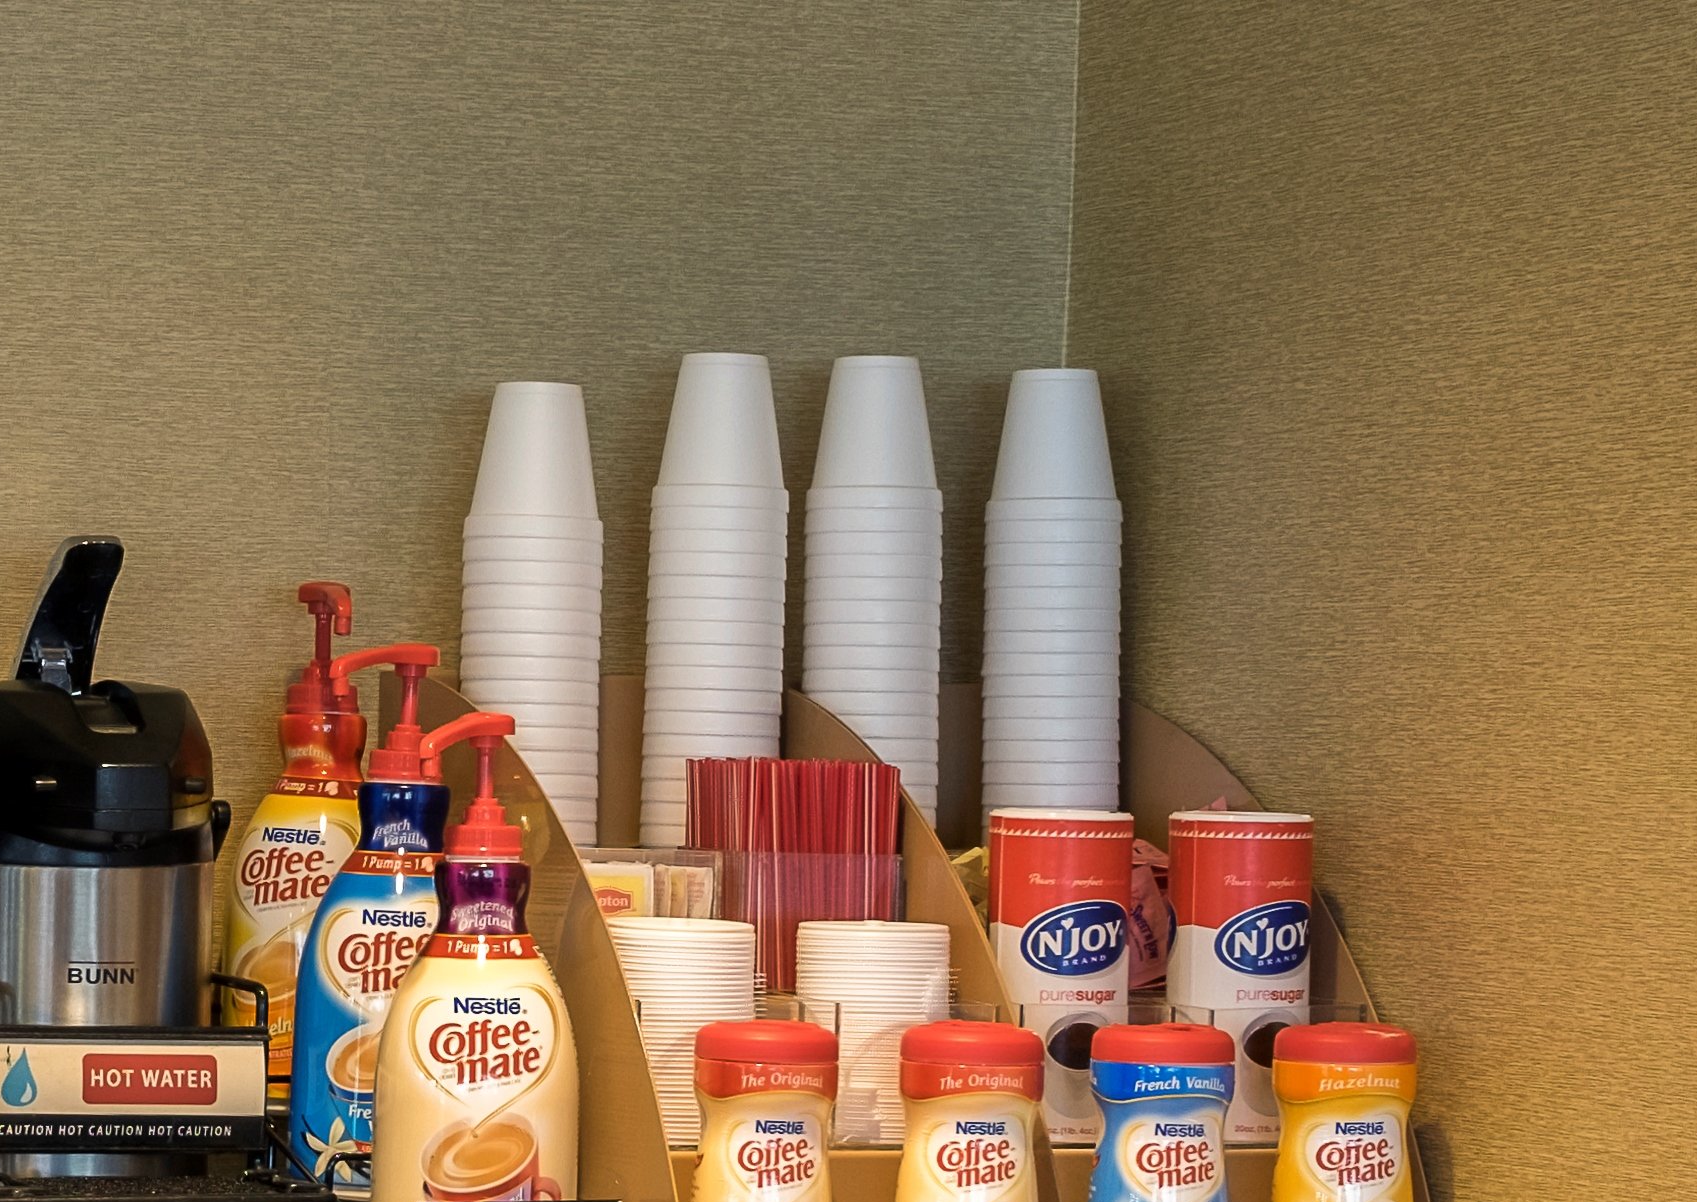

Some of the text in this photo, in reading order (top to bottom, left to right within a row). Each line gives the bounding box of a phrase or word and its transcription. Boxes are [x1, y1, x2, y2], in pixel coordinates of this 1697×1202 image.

[373, 818, 411, 840] French
[383, 831, 429, 848] Vanilla
[370, 856, 401, 872] Pump
[253, 874, 331, 906] mate
[450, 901, 514, 922] Sweetened
[458, 914, 514, 932] Original
[1062, 955, 1106, 966] BRAND
[1257, 954, 1297, 966] BRAND
[67, 967, 135, 984] BUNN
[456, 1047, 540, 1085] mate
[90, 1068, 213, 1089] HOT WATER
[742, 1072, 823, 1088] The Original
[940, 1073, 1023, 1090] The Original
[1134, 1076, 1225, 1092] French Vanilla
[1319, 1073, 1400, 1092] Hazelnut
[58, 1124, 84, 1136] HOT
[88, 1125, 144, 1136] CAUTION
[148, 1125, 173, 1137] HOT
[177, 1125, 232, 1137] CAUTION
[757, 1159, 815, 1188] mate
[957, 1160, 1016, 1187] mate
[1157, 1161, 1215, 1189] mate
[1337, 1158, 1395, 1186] mate
